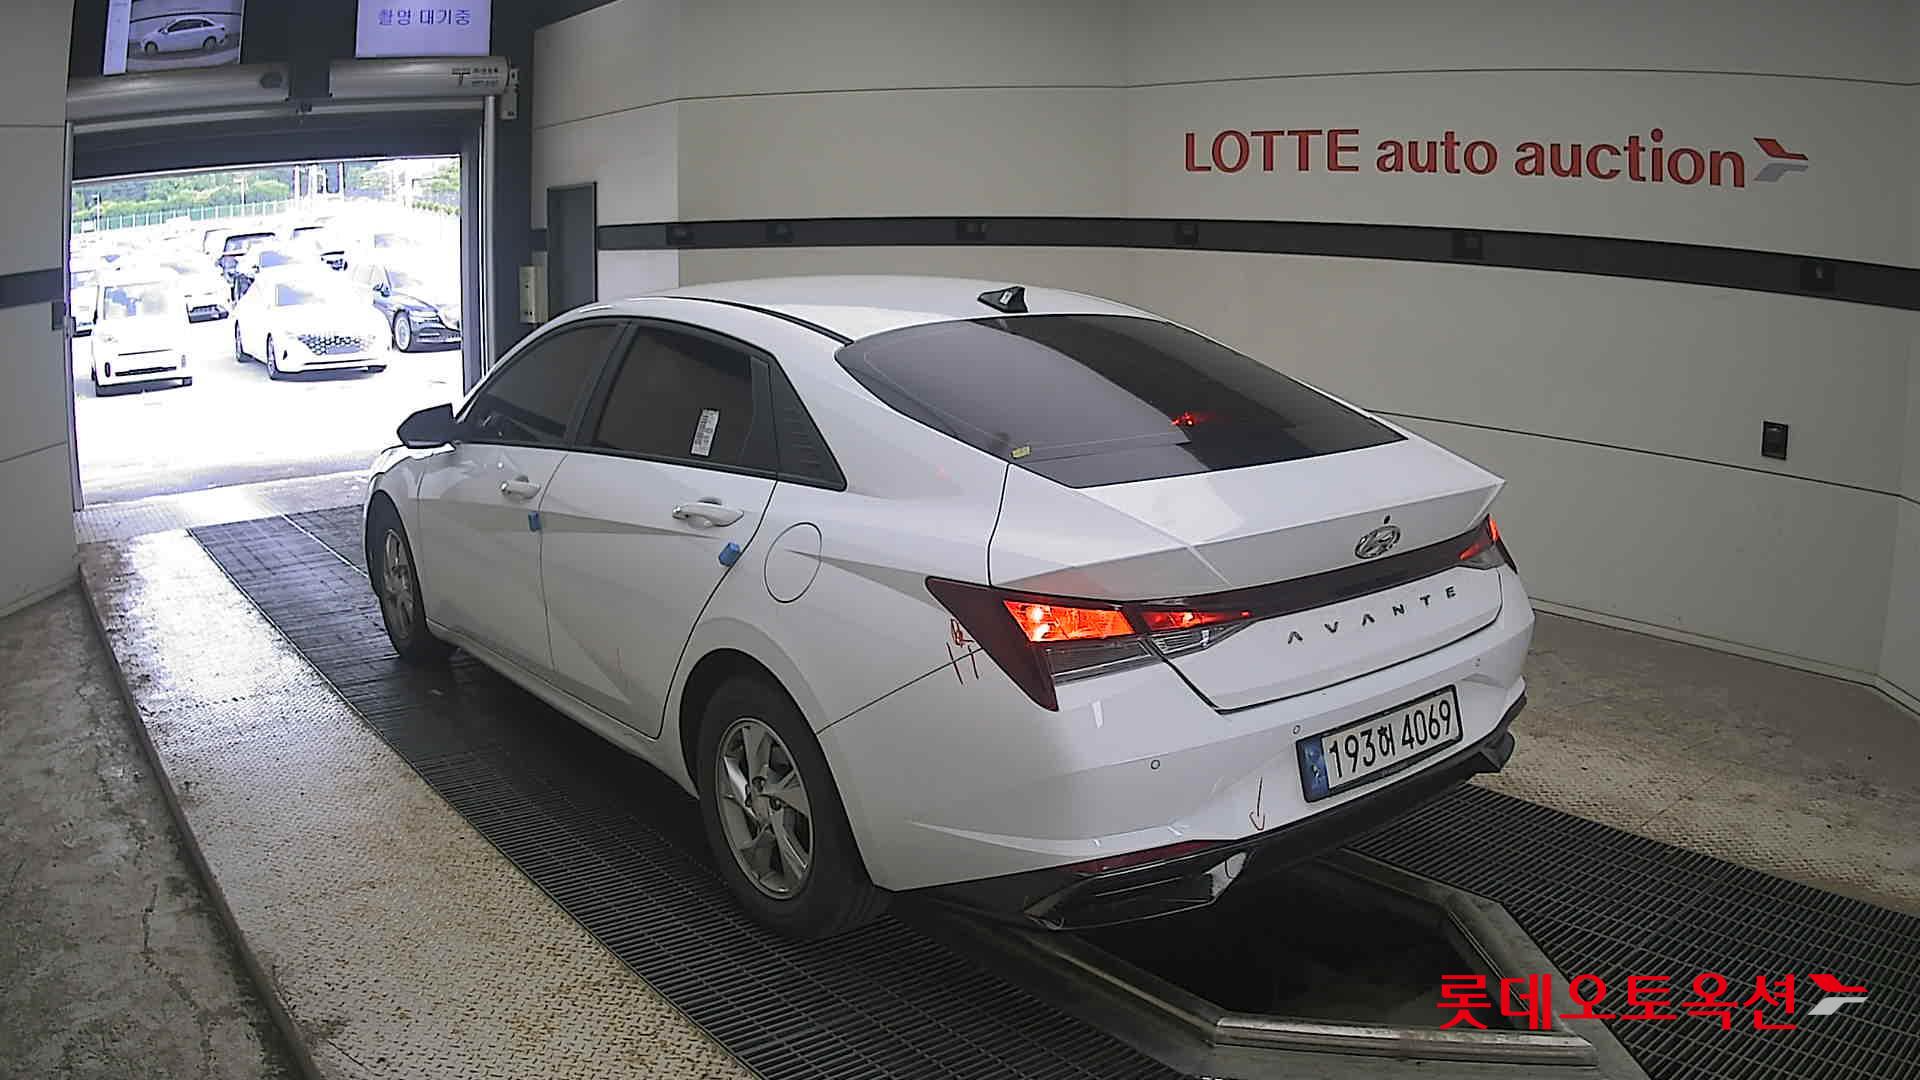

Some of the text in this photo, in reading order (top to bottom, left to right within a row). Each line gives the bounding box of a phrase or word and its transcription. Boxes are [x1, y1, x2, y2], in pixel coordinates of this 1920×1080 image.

[420, 9, 471, 26] 대기중
[1184, 128, 1746, 188] LOTTE auto auction
[1287, 586, 1456, 644] AVANTE
[1329, 699, 1451, 778] 193허 4069
